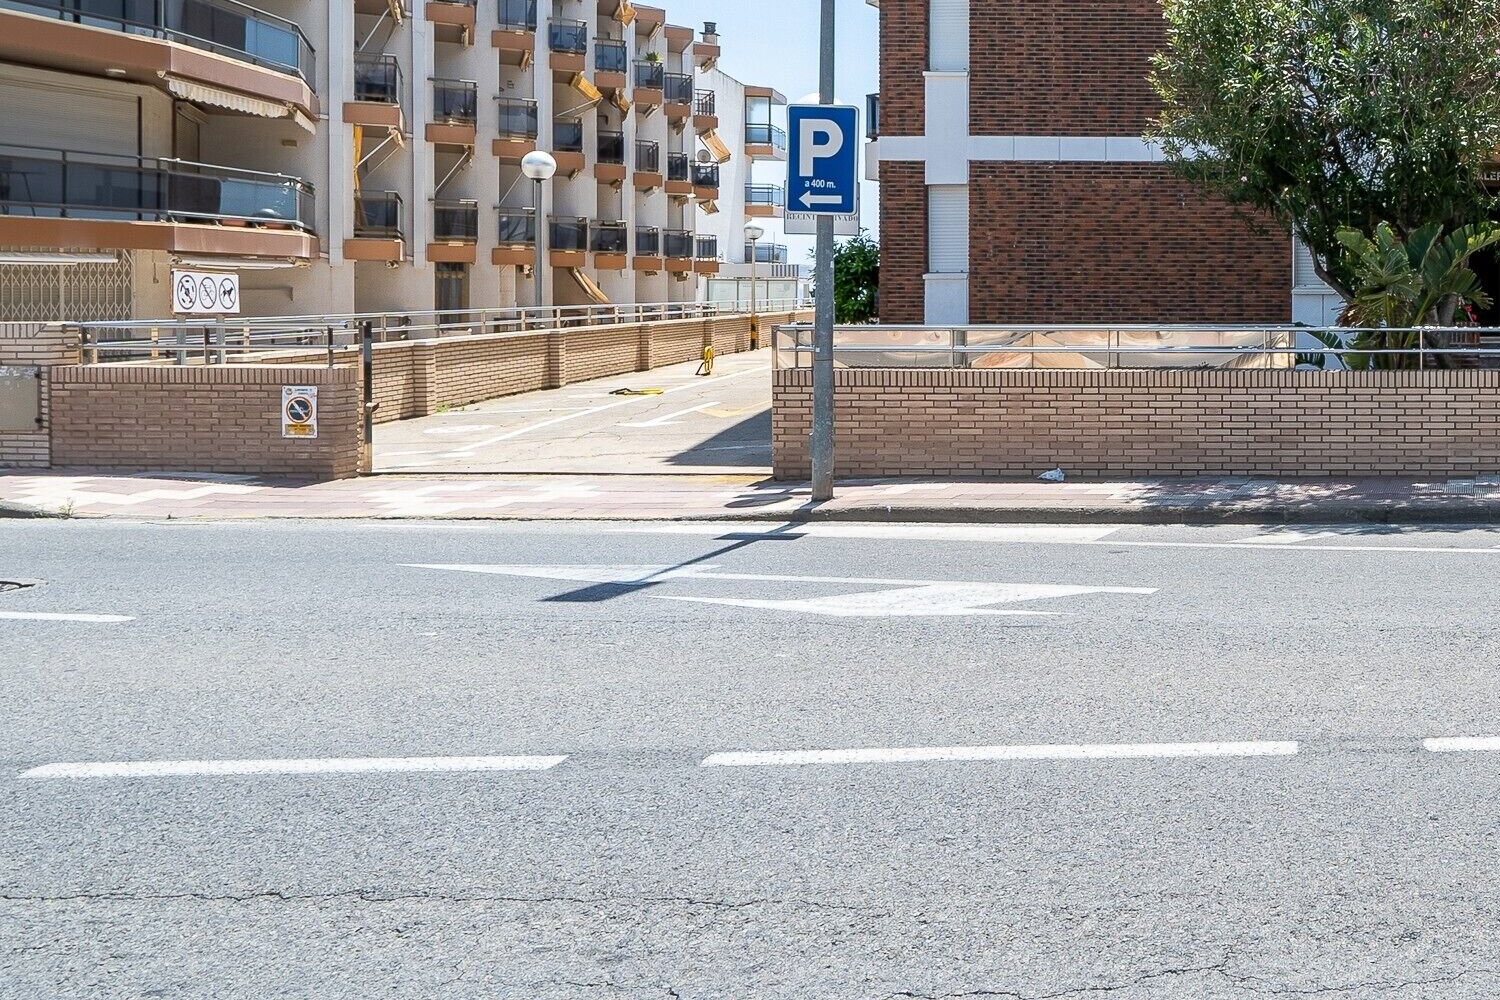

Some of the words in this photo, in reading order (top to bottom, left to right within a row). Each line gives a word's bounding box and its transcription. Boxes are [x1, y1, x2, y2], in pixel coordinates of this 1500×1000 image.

[799, 118, 844, 177] P
[804, 180, 810, 188] a
[811, 179, 825, 188] 400
[826, 181, 836, 189] m.
[786, 213, 816, 221] RECINT
